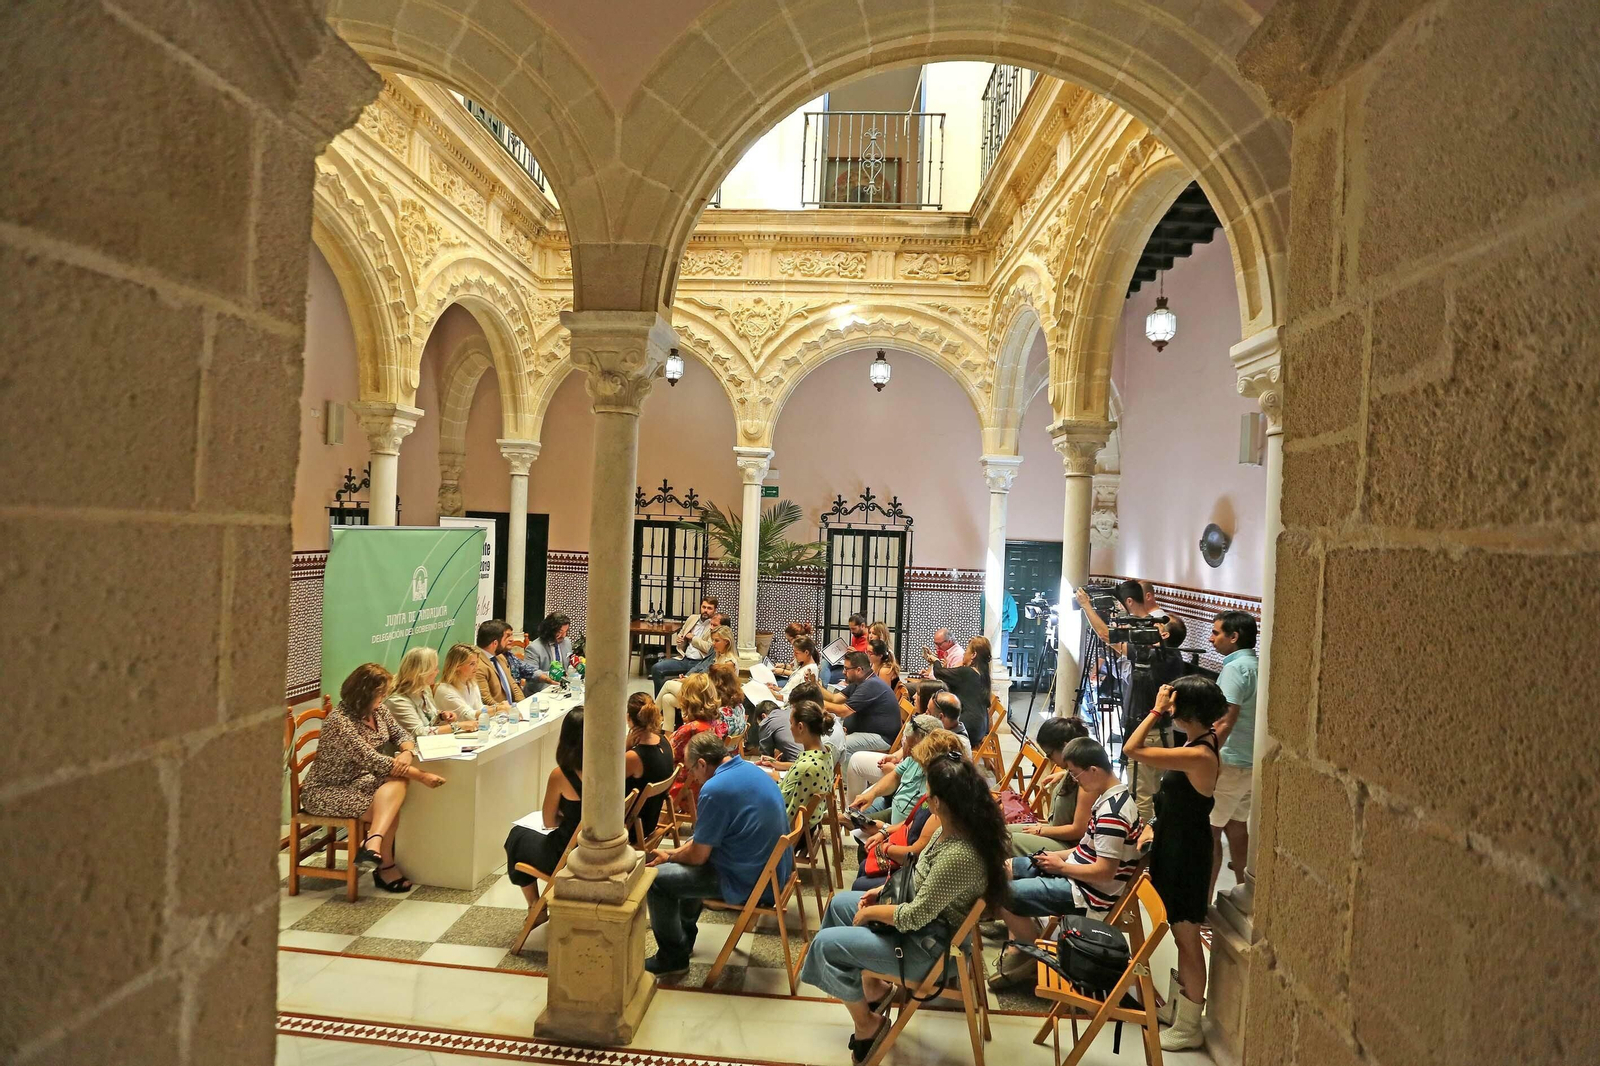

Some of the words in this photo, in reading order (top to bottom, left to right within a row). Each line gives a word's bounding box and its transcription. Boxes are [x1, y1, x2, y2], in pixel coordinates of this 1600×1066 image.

[385, 613, 406, 627] JUNTA
[408, 611, 416, 623] DE
[405, 628, 414, 636] DEL
[415, 623, 437, 634] GOBIERNO
